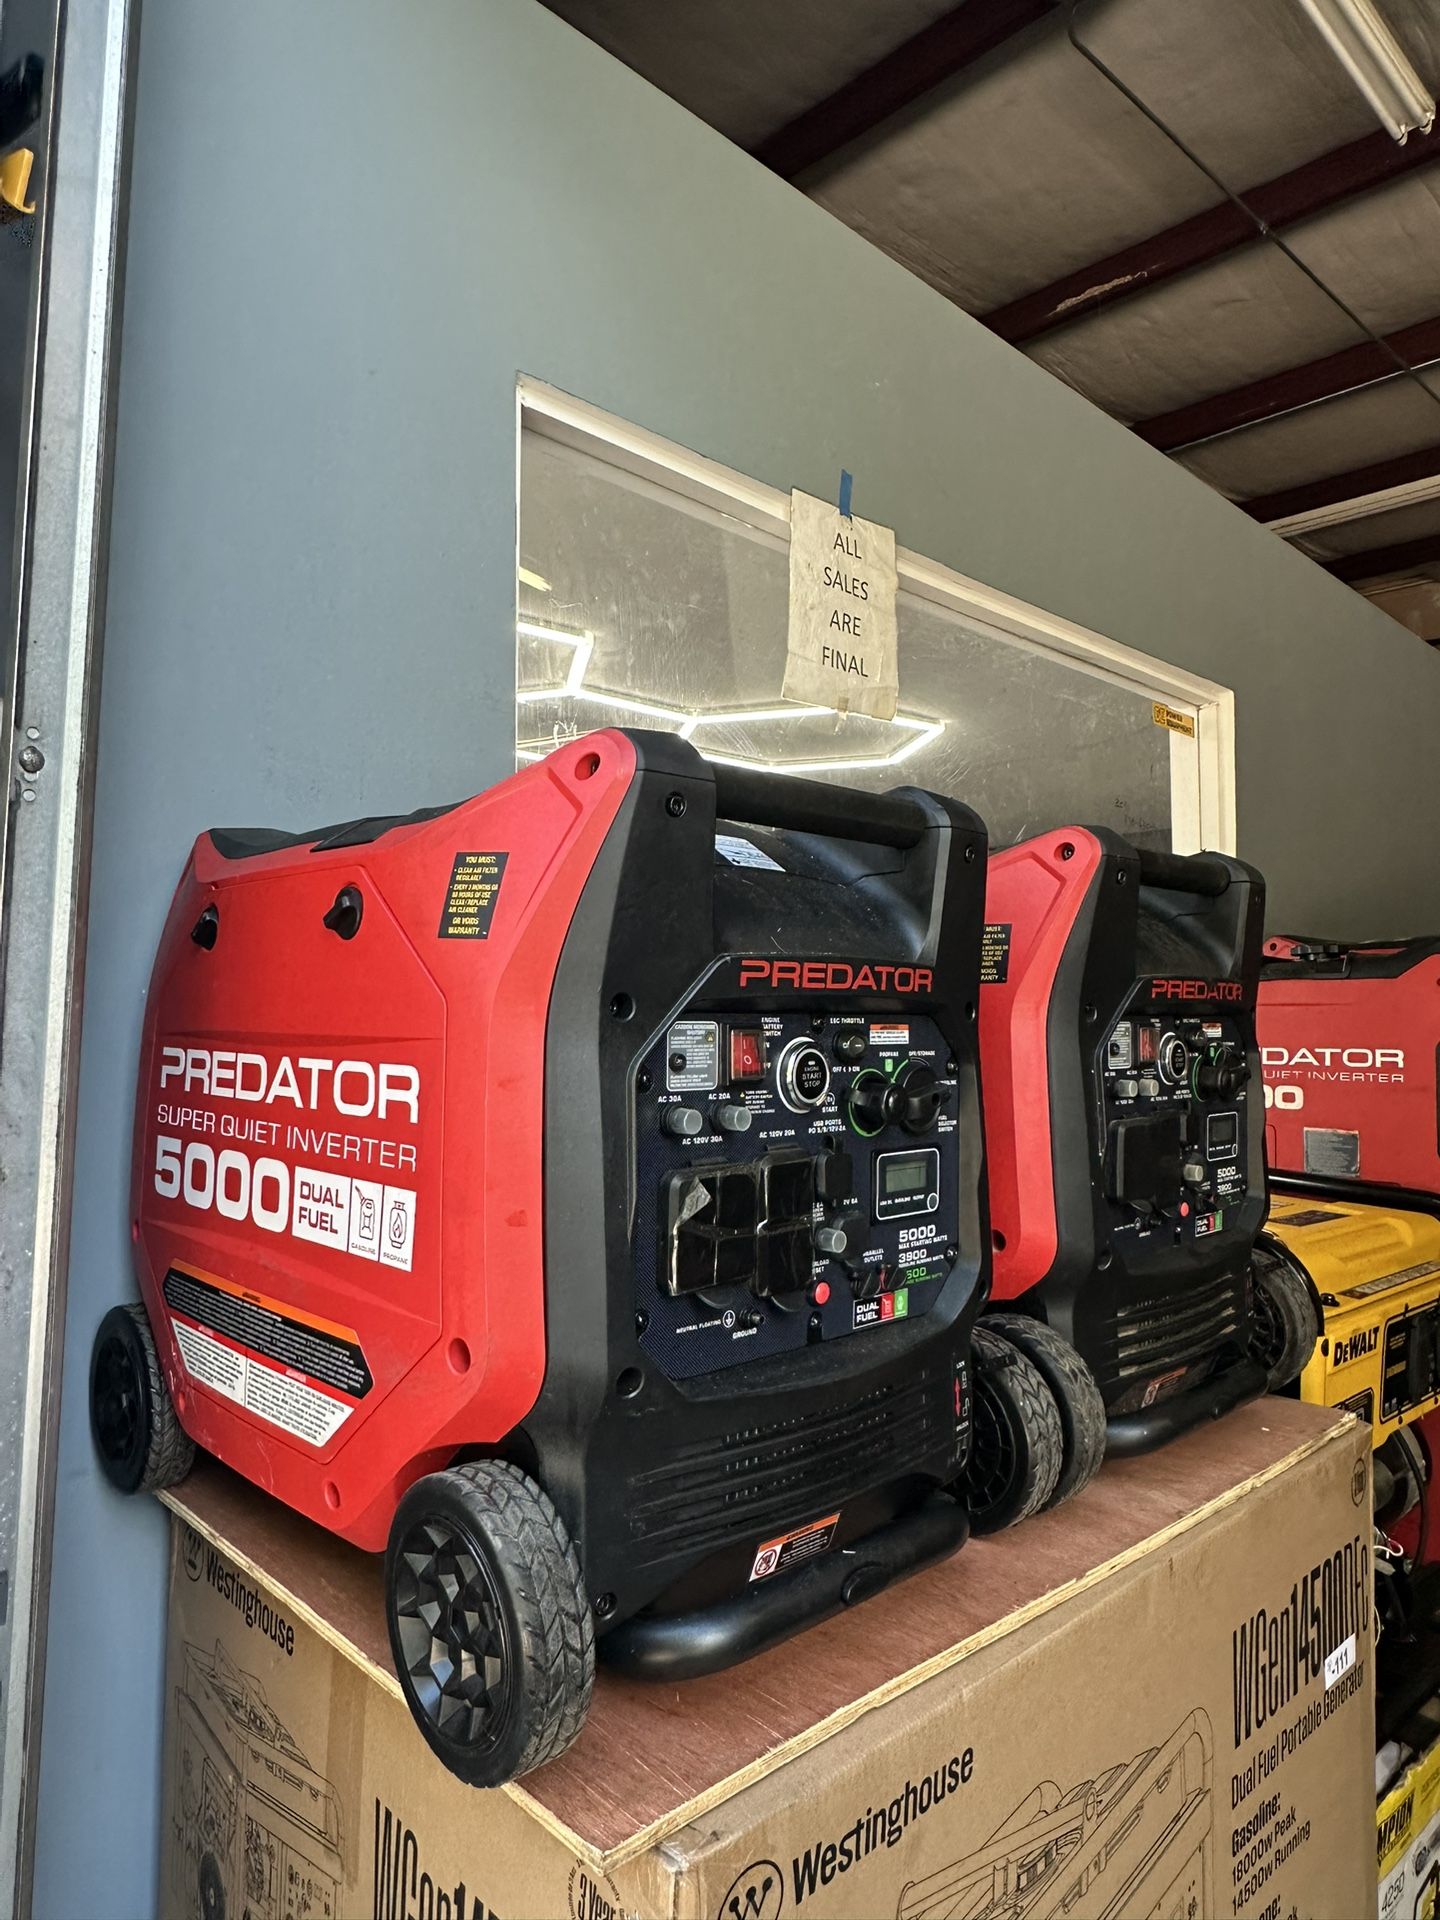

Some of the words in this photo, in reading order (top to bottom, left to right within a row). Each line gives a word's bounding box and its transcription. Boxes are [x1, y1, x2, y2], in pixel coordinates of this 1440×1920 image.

[833, 533, 862, 559] ALL
[823, 566, 869, 600] SALES
[829, 610, 861, 637] ARE
[822, 646, 869, 678] FINAL
[739, 960, 933, 993] PREDATOR
[1151, 979, 1243, 1000] PREDATOR
[1259, 1047, 1405, 1068] DATOR
[160, 1046, 420, 1124] PREDATOR
[802, 1072, 822, 1080] START
[1264, 1070, 1303, 1079] UIET
[1308, 1071, 1404, 1083] INVERTER
[157, 1104, 216, 1134] SUPER
[220, 1114, 281, 1146] QUIET
[286, 1125, 417, 1172] INVERTER
[693, 1136, 709, 1144] 120V
[154, 1135, 290, 1233] 5000
[1217, 1166, 1236, 1178] 5000
[300, 1181, 344, 1209] DUAL
[298, 1206, 339, 1234] FUEL
[899, 1224, 936, 1243] 5000
[898, 1242, 909, 1250] MAX
[911, 1238, 932, 1248] STARTING
[933, 1234, 948, 1243] WATTS
[898, 1248, 927, 1263] 3900
[383, 1251, 409, 1265] PROPANE
[906, 1267, 927, 1280] 500
[856, 1311, 878, 1323] FUEL
[857, 1301, 880, 1314] DUAL
[732, 1327, 758, 1339] GROUND
[206, 1547, 295, 1656] Westinghouse
[1232, 1756, 1256, 1810] Dual
[1258, 1734, 1279, 1784] Fuel
[1281, 1701, 1322, 1762] Portable
[1323, 1660, 1364, 1720] Generator
[793, 1747, 975, 1905] Westinghouse
[1232, 1792, 1281, 1857] Gasoline:
[1377, 1790, 1414, 1858] MPION
[1232, 1832, 1273, 1887] 18000w
[1274, 1806, 1296, 1842] Peak
[1232, 1859, 1273, 1917] 14500w
[1274, 1820, 1311, 1869] Running
